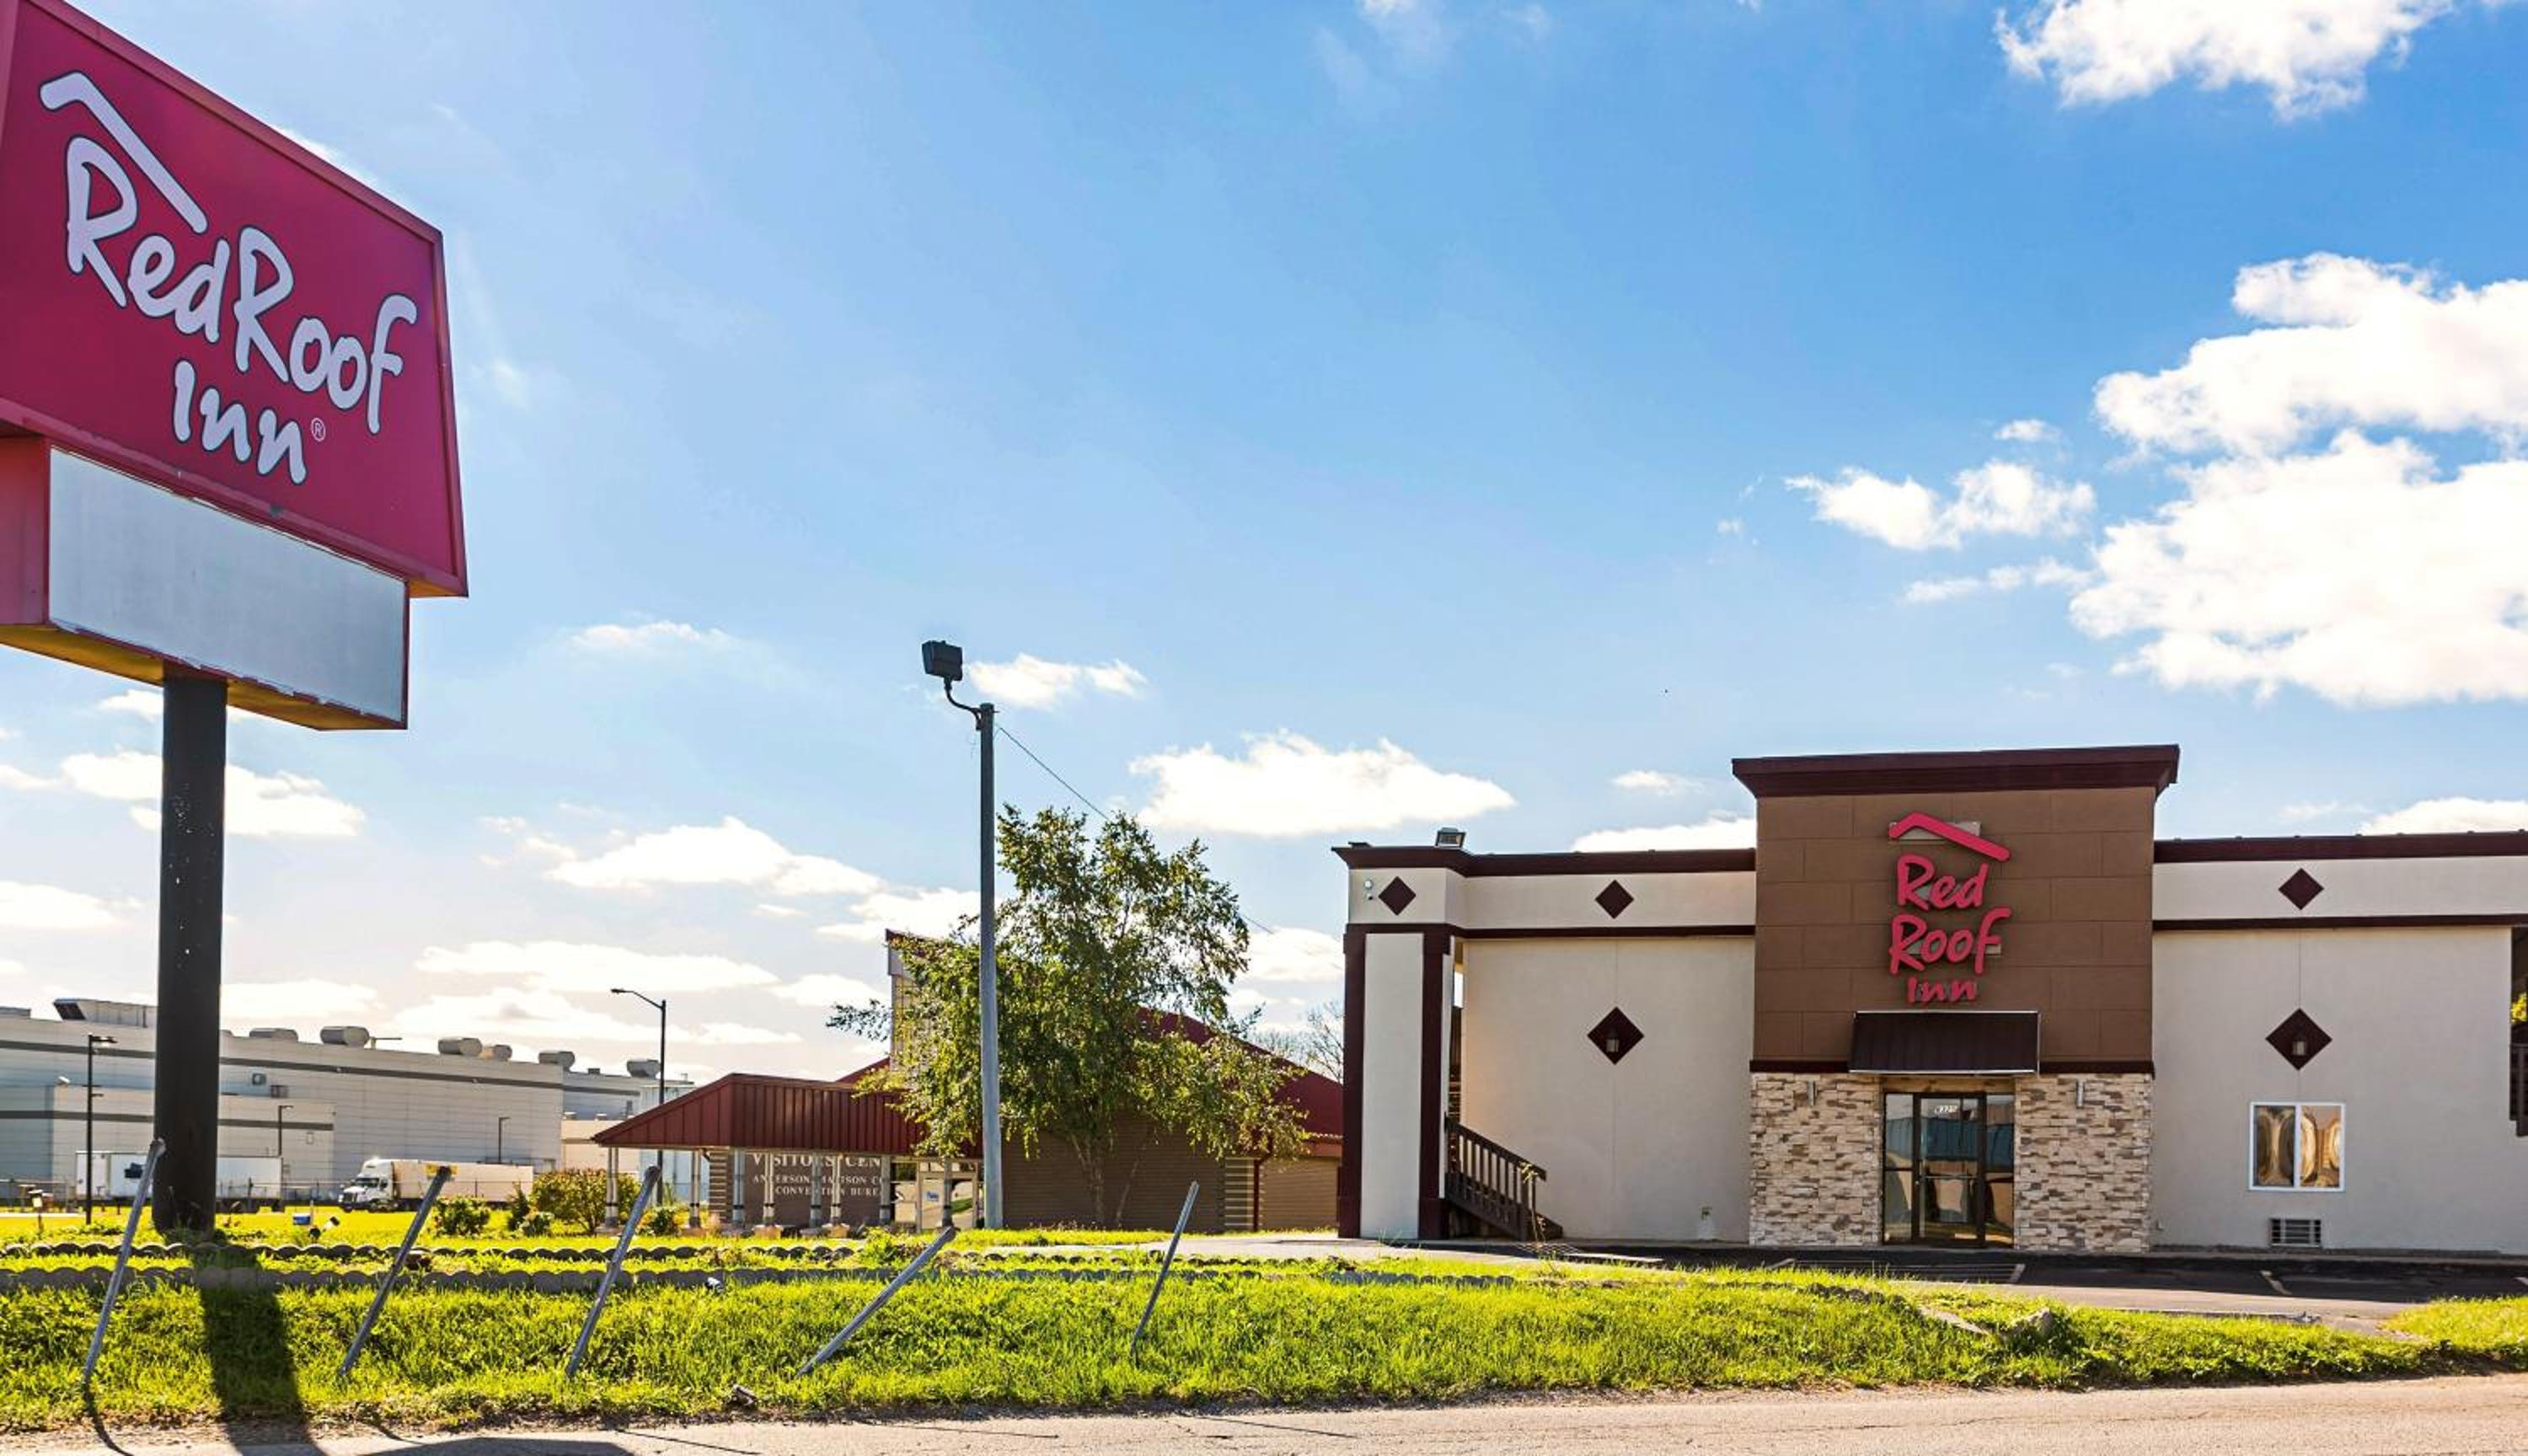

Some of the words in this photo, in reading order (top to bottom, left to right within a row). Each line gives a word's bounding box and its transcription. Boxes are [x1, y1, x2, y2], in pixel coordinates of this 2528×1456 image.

[66, 136, 231, 344] Red
[233, 225, 418, 435] Roof
[172, 359, 308, 484] Inn
[1897, 854, 1990, 912] Red
[1888, 907, 2012, 975] Roof
[1907, 975, 1978, 1005] Inn
[753, 1174, 810, 1184] ANERSON
